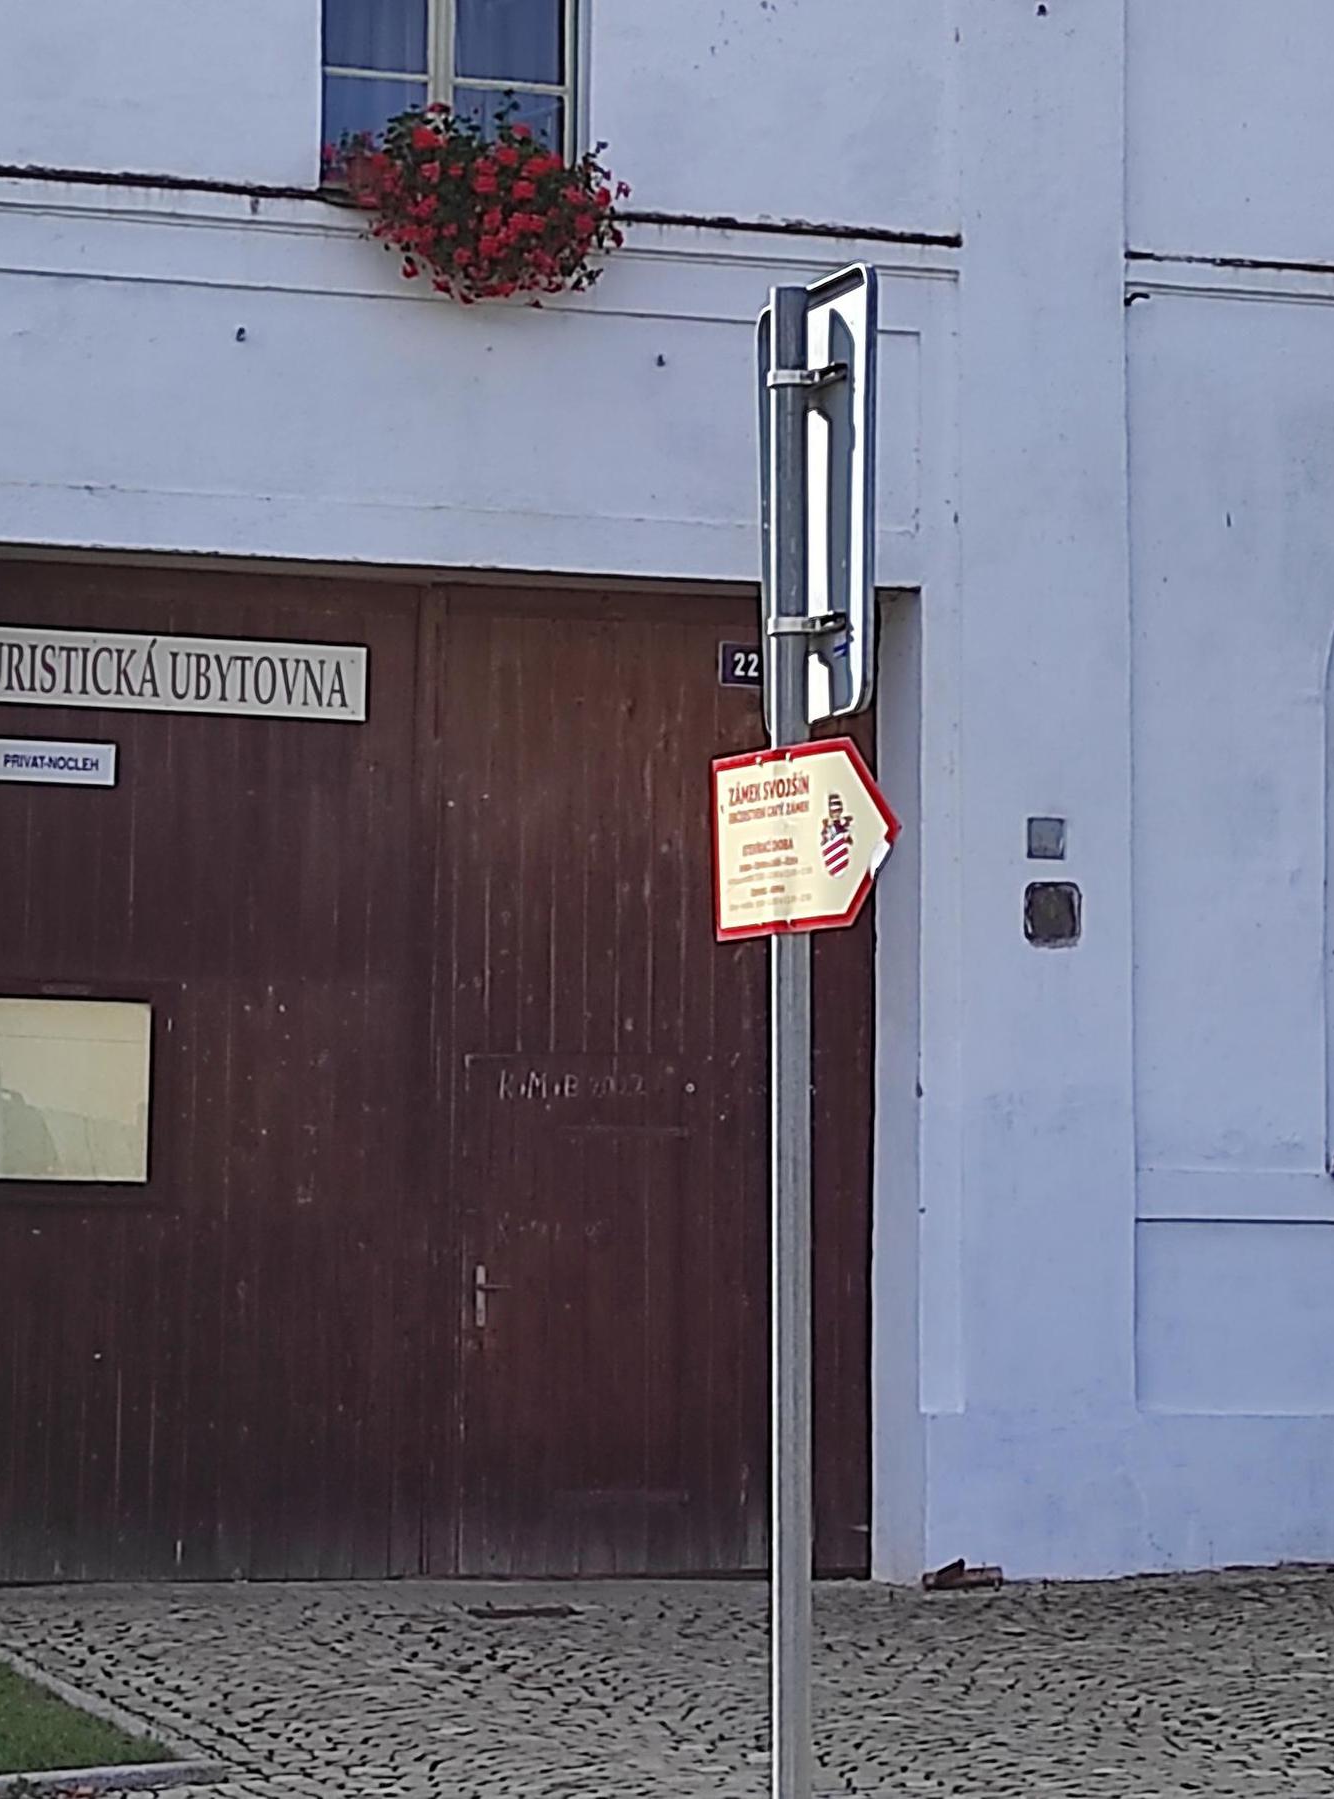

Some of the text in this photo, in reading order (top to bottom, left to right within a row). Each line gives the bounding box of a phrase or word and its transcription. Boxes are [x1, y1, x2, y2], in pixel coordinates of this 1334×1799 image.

[169, 650, 350, 709] UBYTOVNA
[732, 652, 760, 677] 22
[2, 753, 100, 772] PRIVAT-NOCLEH
[728, 772, 810, 807] ZÁMEK SVOJŠÍN
